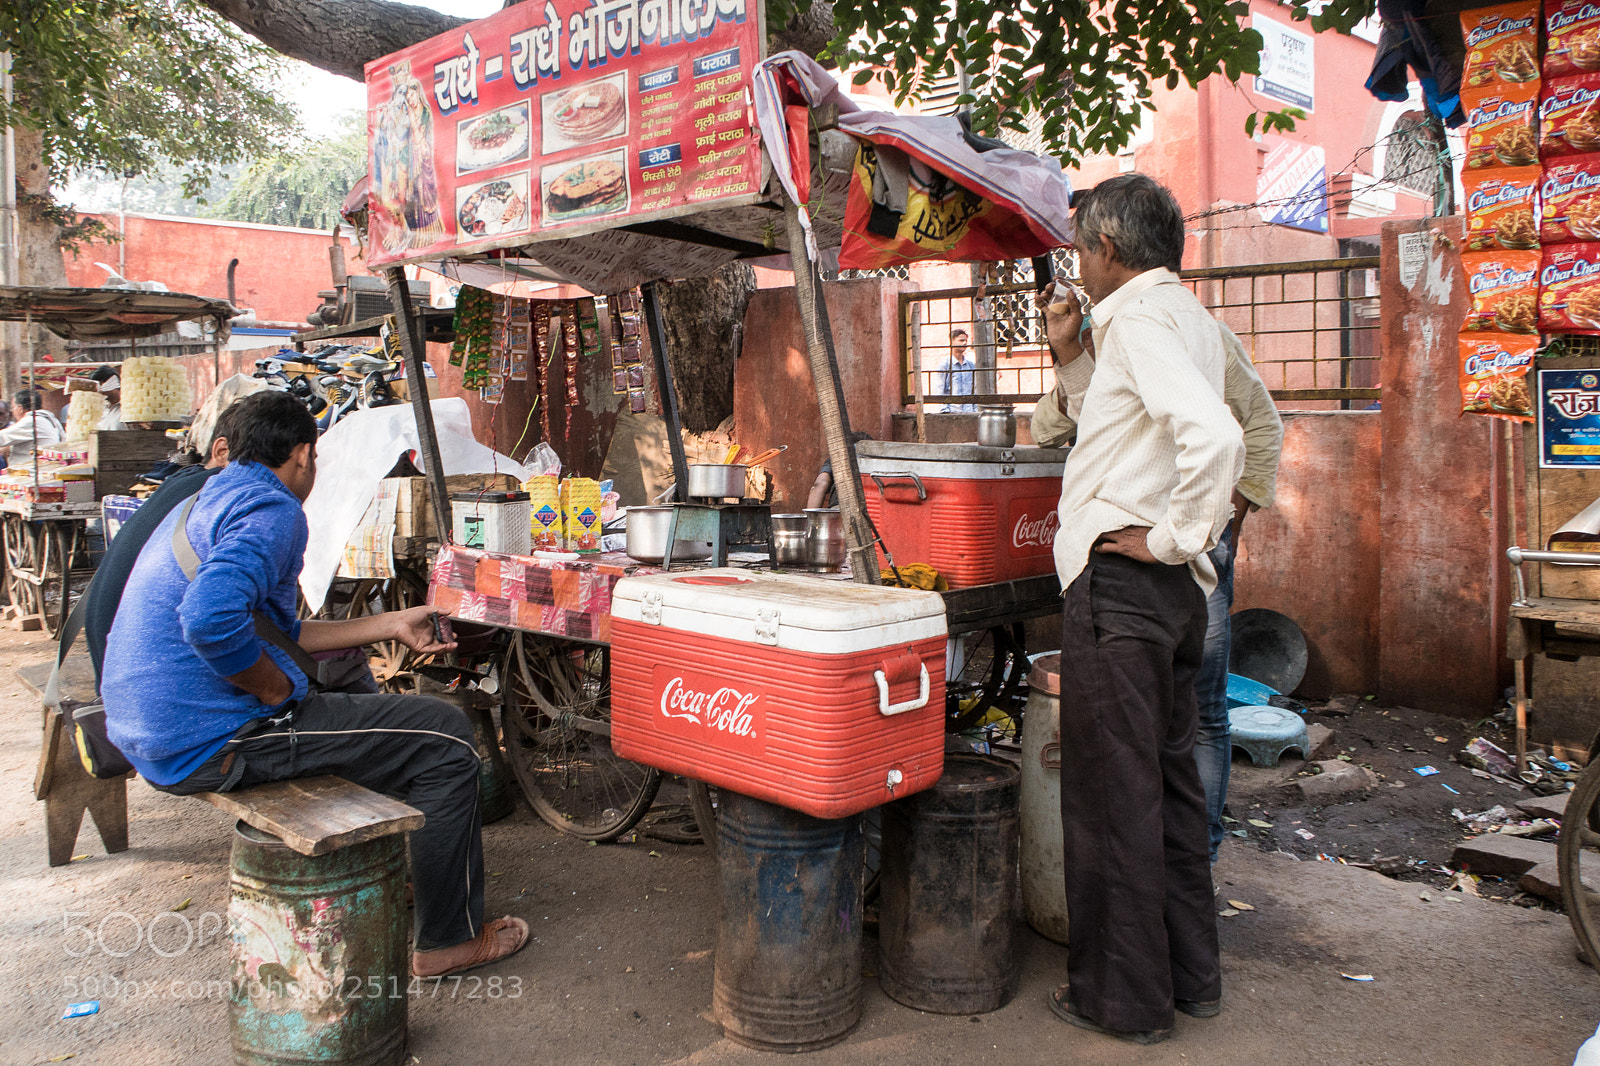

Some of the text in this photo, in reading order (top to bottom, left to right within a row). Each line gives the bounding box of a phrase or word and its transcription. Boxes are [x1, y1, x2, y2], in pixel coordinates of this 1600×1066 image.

[434, 31, 480, 113] राधे
[510, 1, 562, 87] राधे
[701, 54, 731, 70] पराठा
[644, 71, 673, 86] चावल
[694, 78, 717, 92] आलू
[718, 128, 744, 141] पराठा
[648, 149, 671, 163] रोटी
[717, 164, 742, 176] पराठा
[723, 181, 749, 194] पराठा
[1547, 388, 1600, 420] राज
[537, 513, 556, 521] VIP
[580, 515, 596, 523] VIP
[660, 677, 760, 737] Coca-Cola
